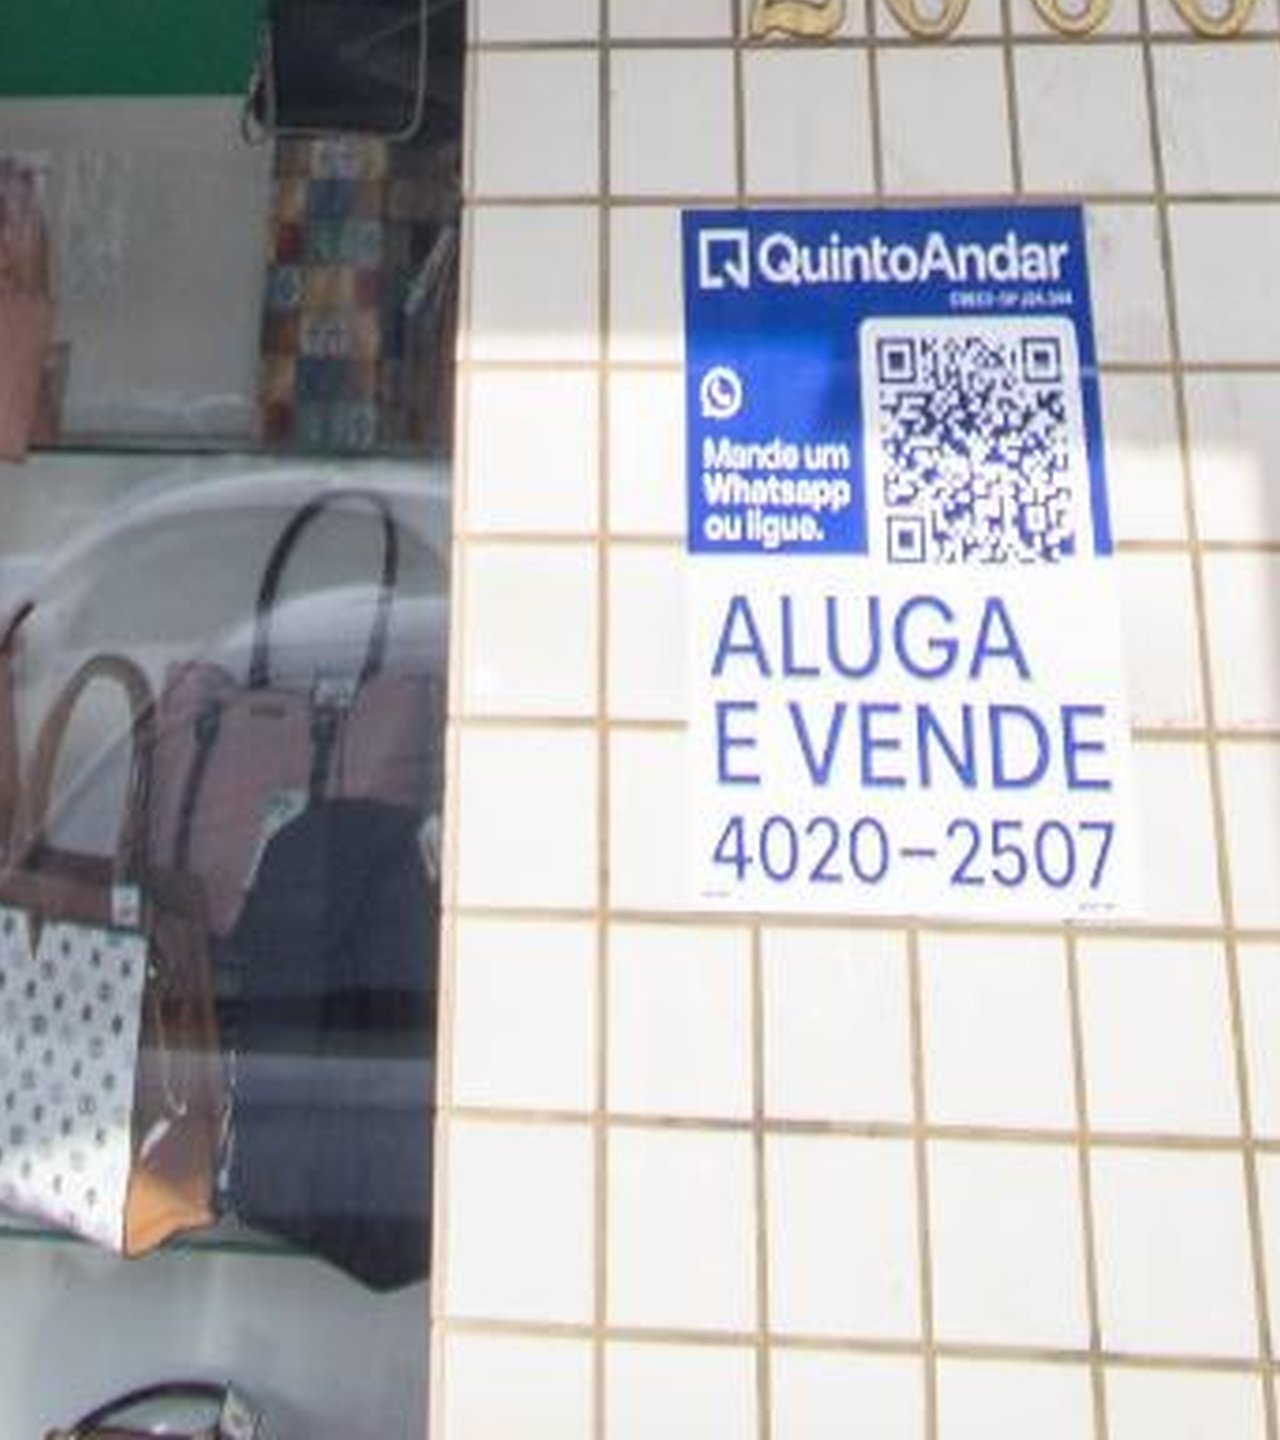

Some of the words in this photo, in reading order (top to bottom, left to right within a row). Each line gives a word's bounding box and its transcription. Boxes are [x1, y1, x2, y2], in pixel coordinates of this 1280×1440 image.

[757, 232, 1071, 285] QuintoAndar
[702, 436, 799, 470] Mande
[803, 443, 851, 470] um
[702, 472, 851, 512] Whatsapp
[704, 514, 742, 541] ou
[747, 509, 825, 549] ligue.
[710, 594, 1032, 683] ALUGA
[715, 700, 763, 787] E
[785, 701, 1114, 793] VENDE
[710, 814, 1118, 892] 4020-2507
